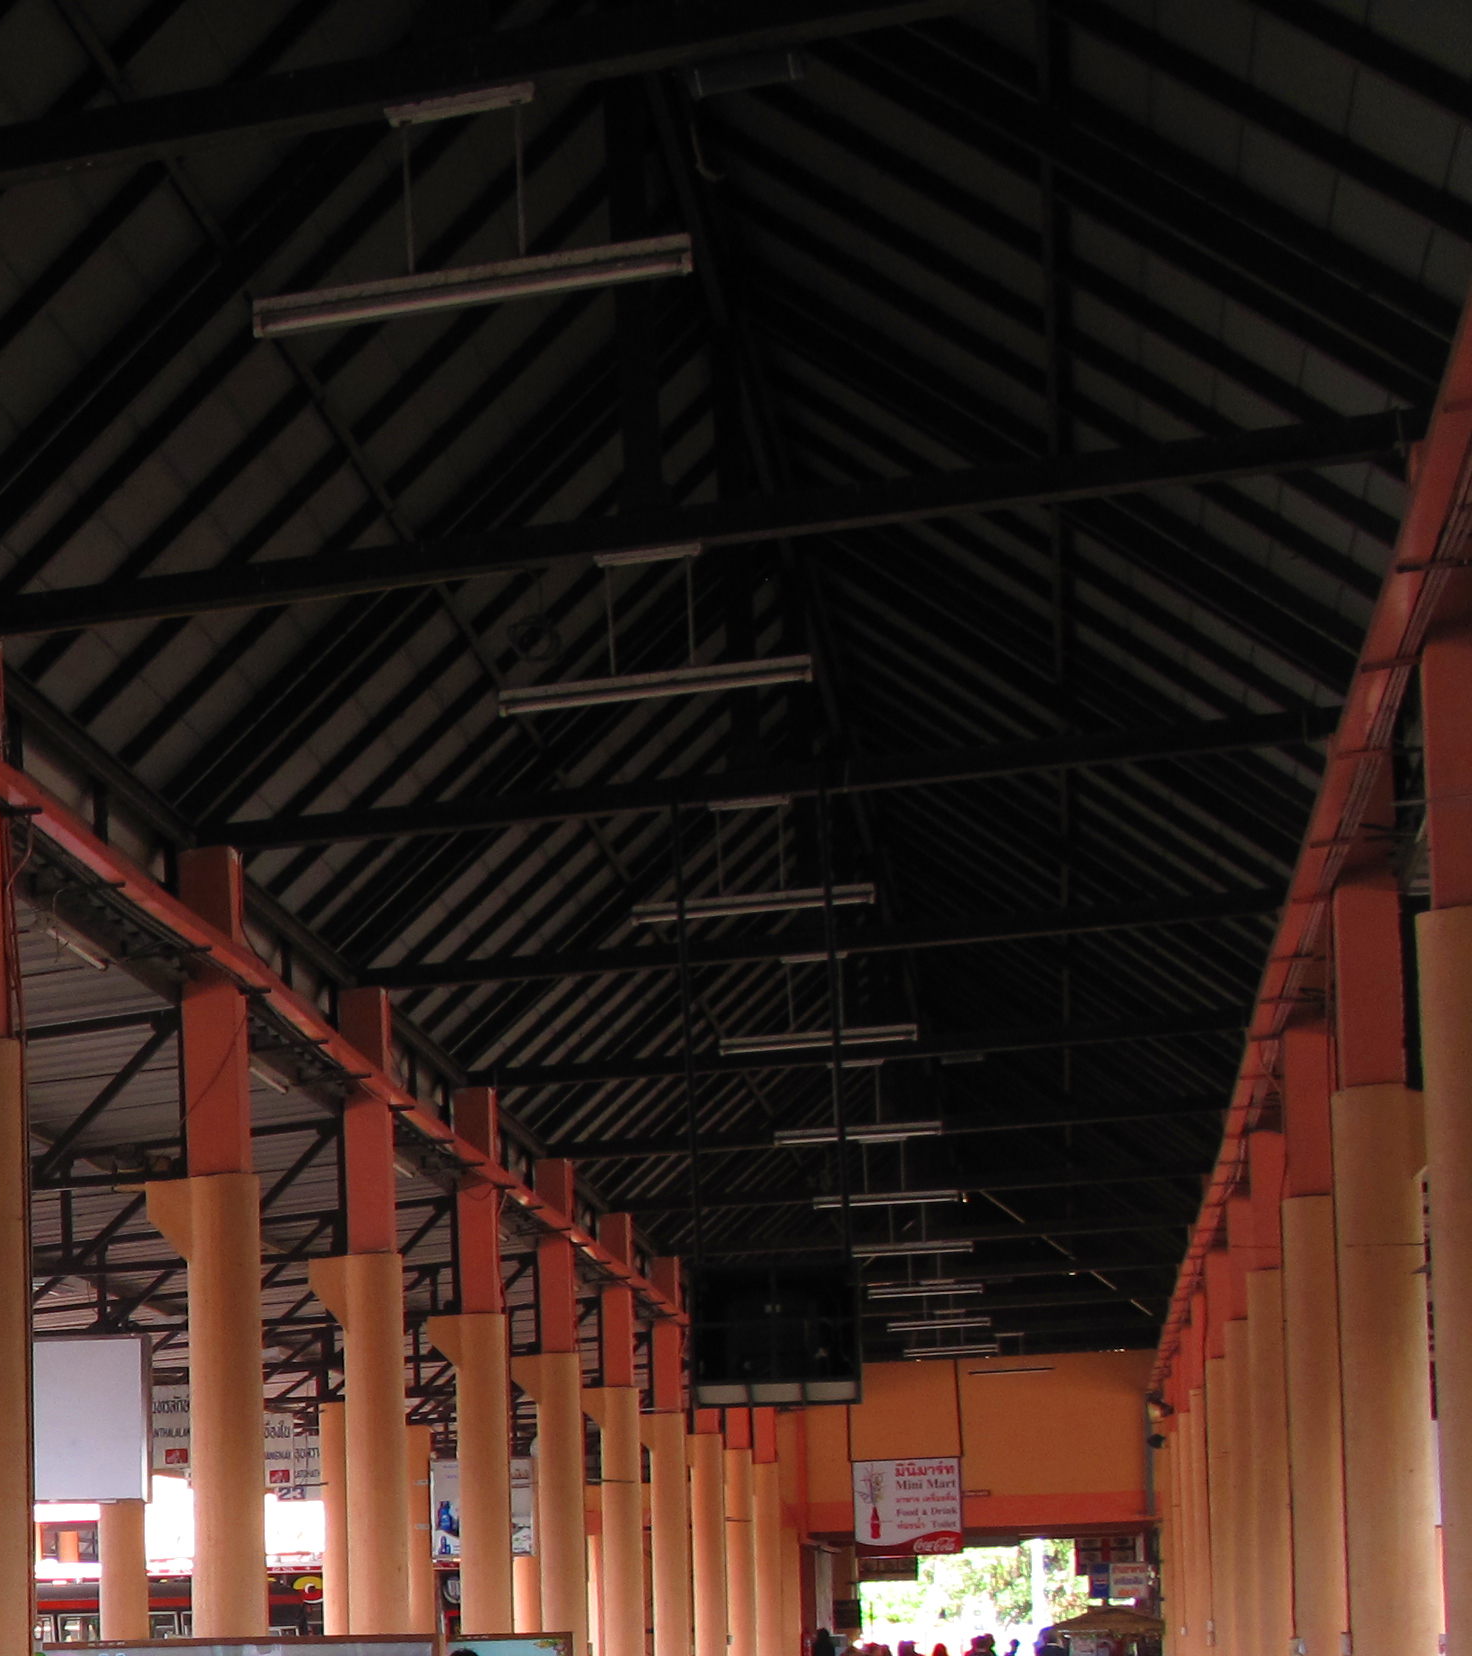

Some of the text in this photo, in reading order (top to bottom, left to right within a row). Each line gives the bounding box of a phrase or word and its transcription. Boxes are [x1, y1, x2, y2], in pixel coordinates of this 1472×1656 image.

[896, 1479, 956, 1490] Mini Mart
[278, 1487, 305, 1500] 23
[913, 1537, 956, 1553] Coca-Cola
